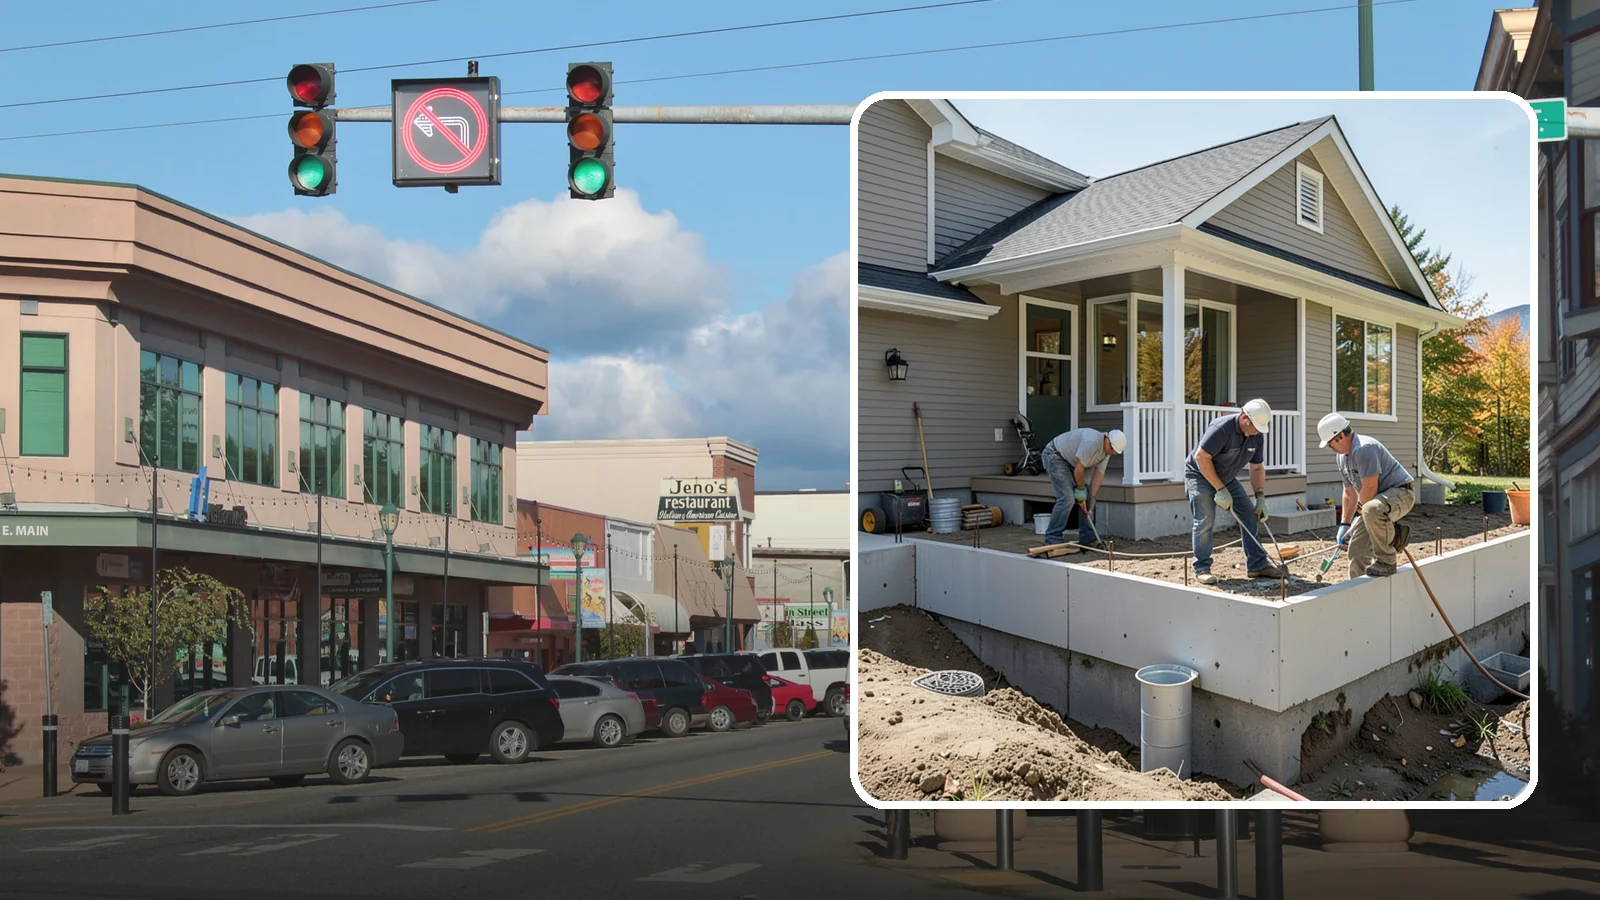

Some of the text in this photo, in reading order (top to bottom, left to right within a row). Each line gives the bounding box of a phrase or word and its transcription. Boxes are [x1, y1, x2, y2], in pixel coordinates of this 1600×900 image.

[669, 480, 727, 494] Jeno's
[665, 496, 731, 509] restaurant
[658, 509, 681, 520] Italian
[686, 509, 714, 519] American
[715, 509, 738, 519] Cuisine
[2, 525, 49, 536] E. MAIN
[785, 608, 795, 617] in
[797, 608, 828, 617] Street
[790, 619, 824, 627] lass
